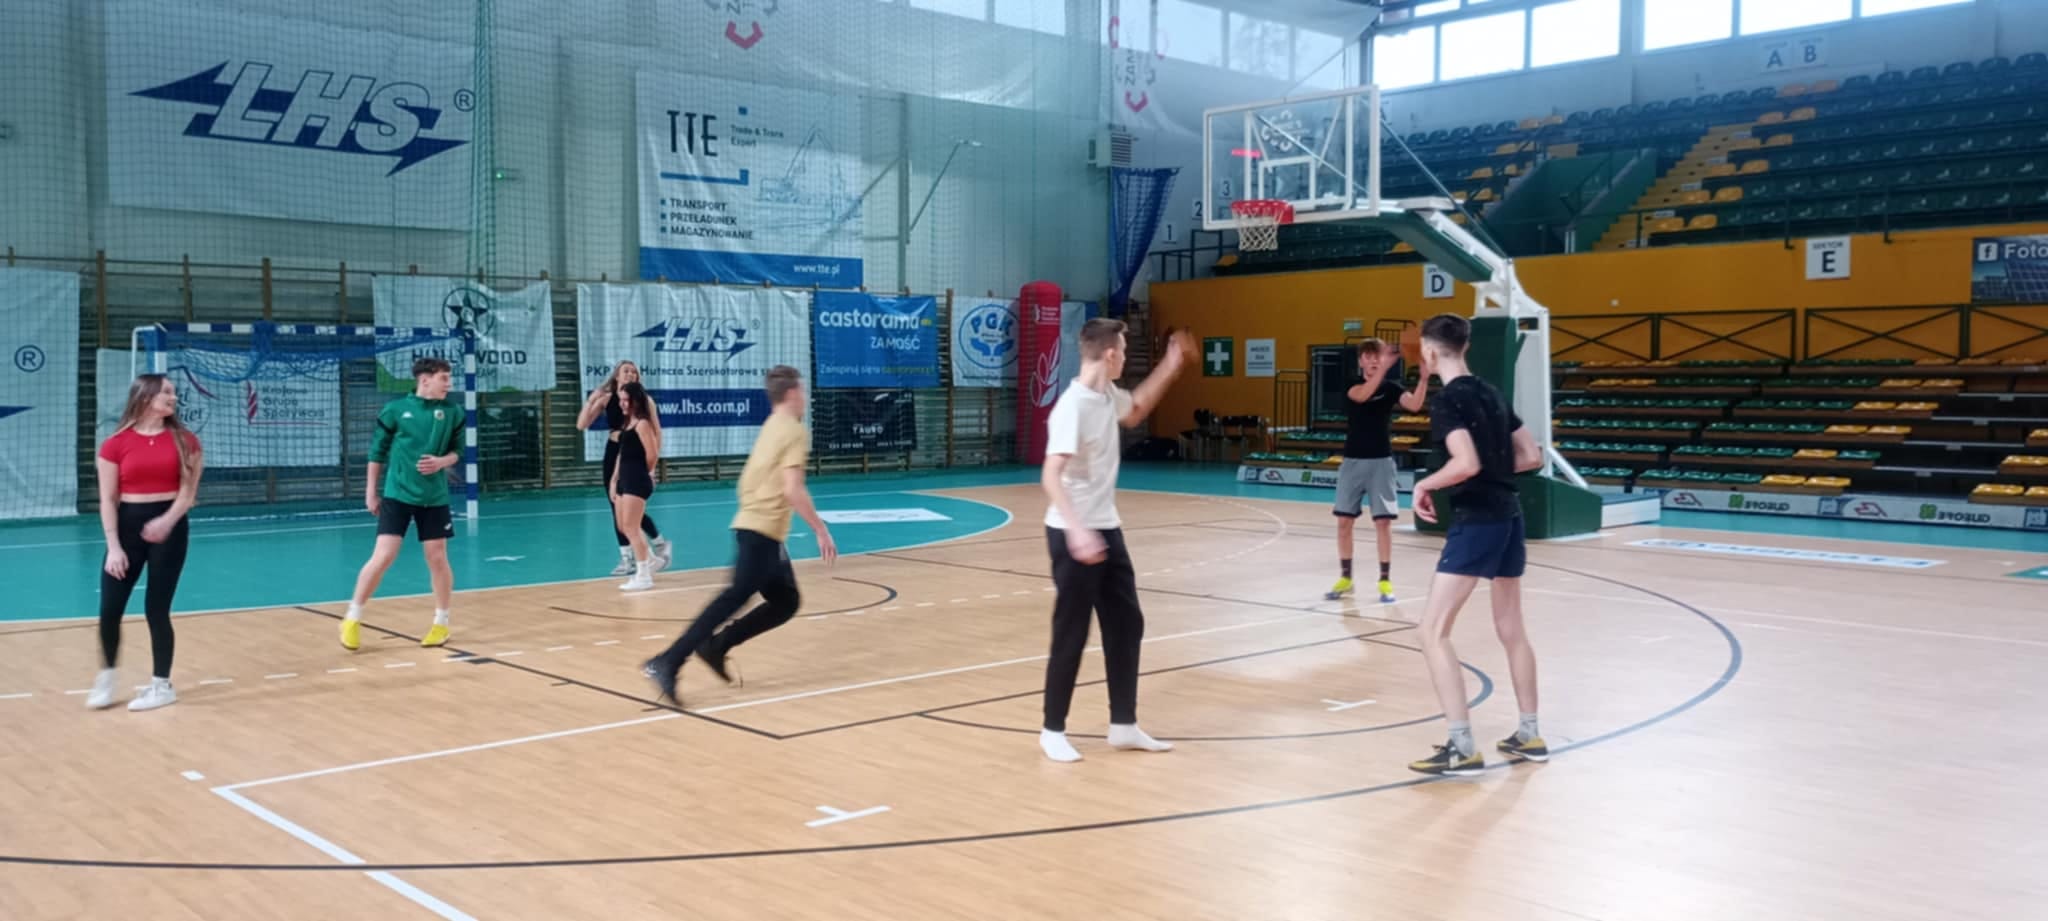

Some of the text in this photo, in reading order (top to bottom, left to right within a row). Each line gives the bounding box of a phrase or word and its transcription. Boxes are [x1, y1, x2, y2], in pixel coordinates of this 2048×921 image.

[1766, 50, 1783, 68] A
[1803, 45, 1816, 63] B
[208, 60, 431, 152] LHS
[667, 110, 718, 157] TTE
[1222, 180, 1231, 197] 3
[670, 198, 728, 212] TRANSPORT
[1194, 201, 1203, 217] 2
[670, 212, 737, 226] PRZEŁADUNEK
[670, 225, 753, 240] MAGAZYNOWANIE
[1167, 224, 1172, 241] 1
[793, 262, 841, 278] www.tte.pl
[1822, 250, 1836, 273] E
[1431, 274, 1445, 293] D
[820, 308, 920, 330] castorama
[969, 312, 1014, 337] PGK
[662, 316, 740, 351] LHS
[585, 366, 611, 377] PKP
[656, 398, 751, 417] ww.lhs.com.pl
